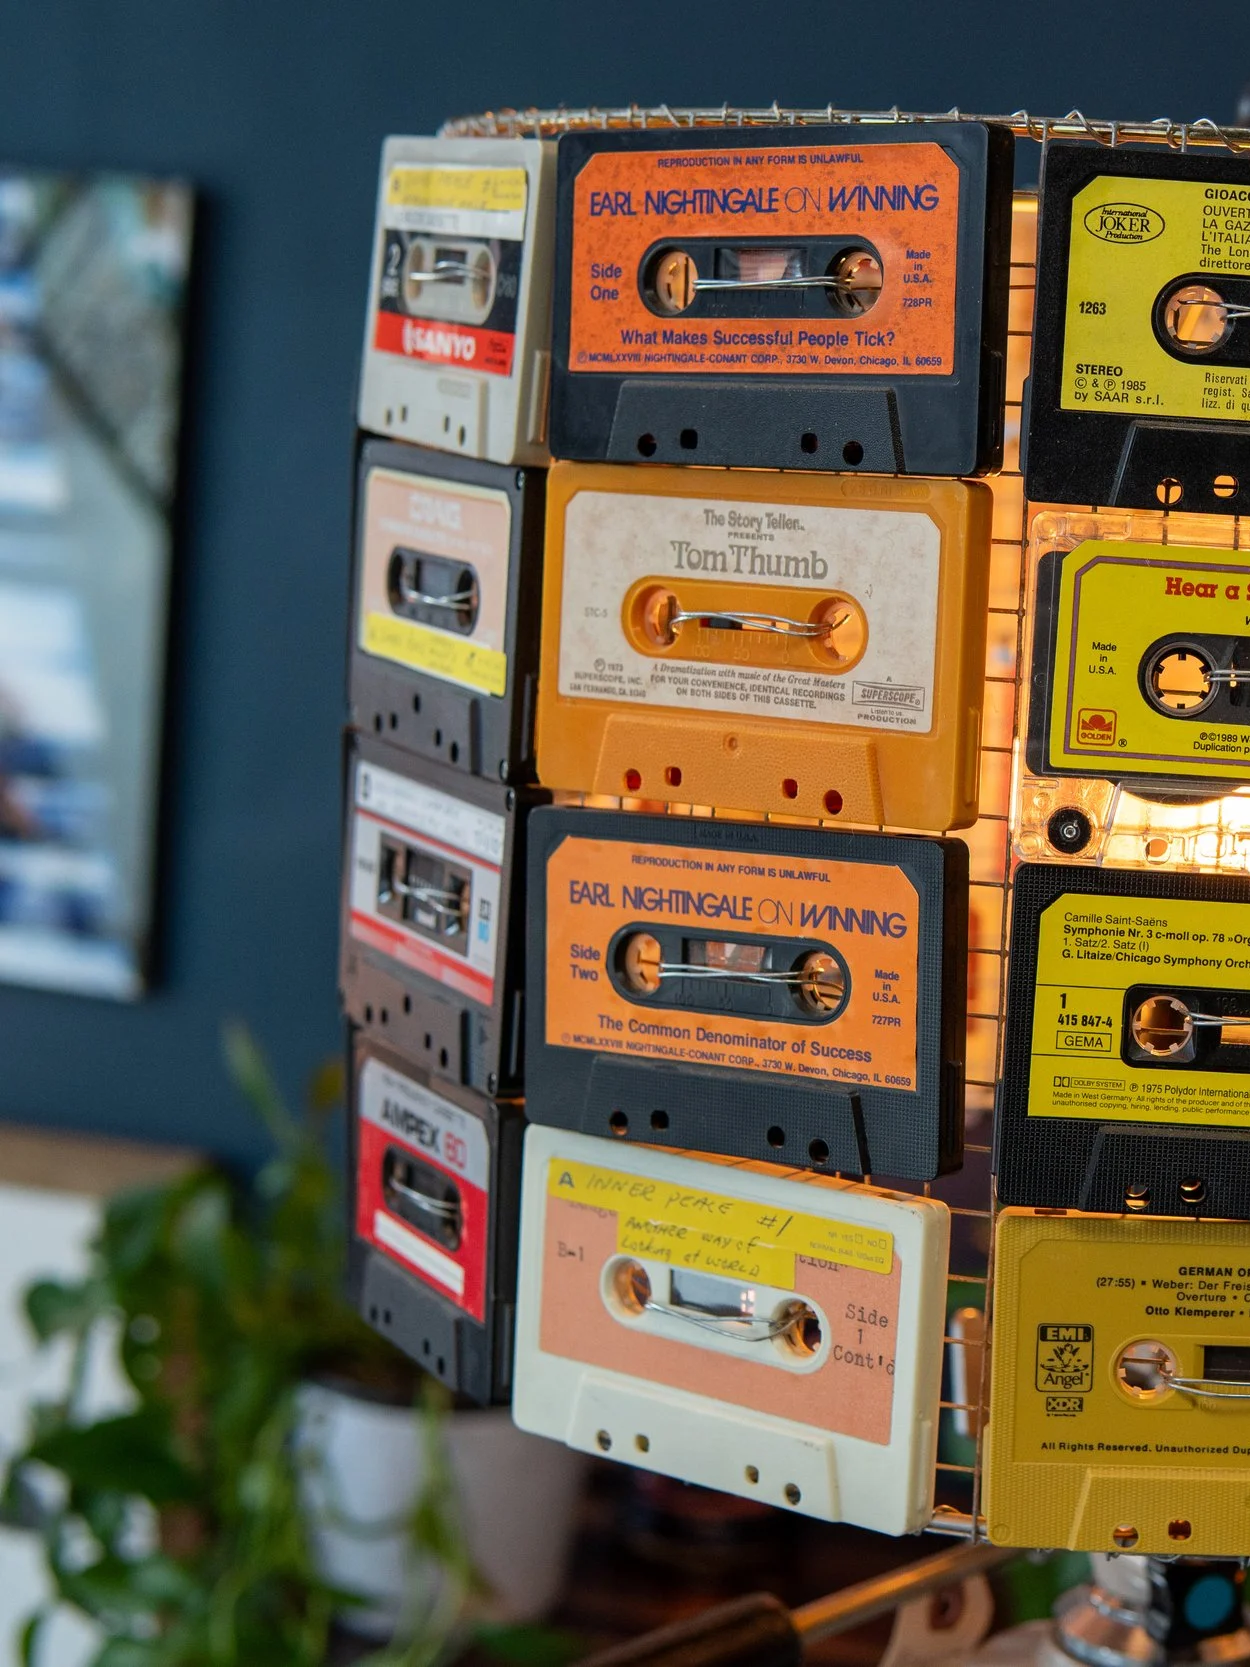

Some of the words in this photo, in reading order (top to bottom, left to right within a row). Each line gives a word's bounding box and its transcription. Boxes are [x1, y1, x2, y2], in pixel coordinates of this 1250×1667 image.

[657, 156, 731, 169] REPRODUCTION
[732, 155, 743, 166] IN
[745, 155, 765, 166] ANY
[767, 154, 796, 165] FORM
[798, 154, 808, 165] IS
[809, 153, 864, 165] UNLAWFUL
[589, 190, 638, 217] EARL
[644, 187, 779, 216] NIGHTINGALE
[784, 187, 821, 214] ON
[828, 183, 940, 213] WINNING
[1101, 207, 1148, 218] International
[1096, 216, 1151, 233] JOKER
[1202, 217, 1218, 230] LA
[1105, 231, 1143, 241] Production
[906, 249, 931, 260] Made
[591, 264, 622, 279] Side
[913, 262, 922, 272] in
[903, 274, 932, 284] U.S.A.
[591, 286, 618, 300] One
[903, 298, 933, 308] 728PR
[1078, 302, 1106, 315] 1263
[620, 329, 658, 345] What
[661, 329, 708, 346] Makes
[713, 329, 793, 347] Successful
[797, 330, 849, 350] People
[854, 330, 895, 347] Tick?
[1075, 363, 1123, 376] STEREO
[1074, 390, 1089, 403] by
[1094, 390, 1129, 404] SAAR
[1135, 394, 1164, 406] s.r.l.
[703, 508, 726, 527] The
[727, 509, 763, 533] Story
[727, 530, 775, 542] PRESENTS
[670, 540, 728, 573] Tom
[728, 544, 828, 580] Thumb
[1164, 576, 1219, 599] Hear
[1224, 584, 1241, 601] a
[1092, 641, 1117, 652] Made
[1099, 654, 1108, 663] in
[1088, 665, 1116, 675] U.S.A.
[1081, 732, 1112, 741] GOLDEN
[569, 879, 615, 908] EARL
[622, 885, 753, 922] NIGHTINGALE
[757, 898, 793, 926] ON
[800, 902, 908, 939] WINNING
[1064, 911, 1103, 924] Camille
[1104, 914, 1168, 928] Saint-Saëns
[1063, 923, 1126, 938] Symphonie
[1127, 927, 1144, 938] Nr.
[1146, 929, 1153, 939] 3
[1155, 931, 1190, 941] c-moll
[1191, 933, 1209, 944] op.
[1212, 932, 1225, 943] 78
[570, 944, 600, 960] Side
[1061, 948, 1074, 959] G.
[1076, 949, 1161, 966] Litaize/Chicago
[1163, 954, 1223, 970] Symphony
[570, 964, 599, 981] Two
[875, 969, 899, 980] Made
[883, 981, 891, 990] in
[872, 992, 900, 1004] U.S.A.
[1060, 993, 1067, 1008] 1
[872, 1015, 901, 1026] 727PR
[1057, 1013, 1078, 1026] 415
[1081, 1014, 1113, 1028] 847-4
[598, 1013, 624, 1032] The
[628, 1018, 691, 1040] Common
[695, 1026, 788, 1052] Denominator
[790, 1039, 807, 1055] of
[810, 1040, 873, 1064] Success
[1064, 1035, 1103, 1048] GEMA
[382, 1098, 440, 1151] AMPEX
[558, 1172, 574, 1188] A
[586, 1173, 655, 1201] INNER
[665, 1191, 734, 1215] PEACE
[1178, 1266, 1233, 1277] GERMAN
[845, 1303, 889, 1328] Side
[1145, 1305, 1170, 1316] Otto
[1174, 1306, 1236, 1319] Klemperer
[1046, 1328, 1085, 1341] EMI
[1043, 1373, 1083, 1389] Angel
